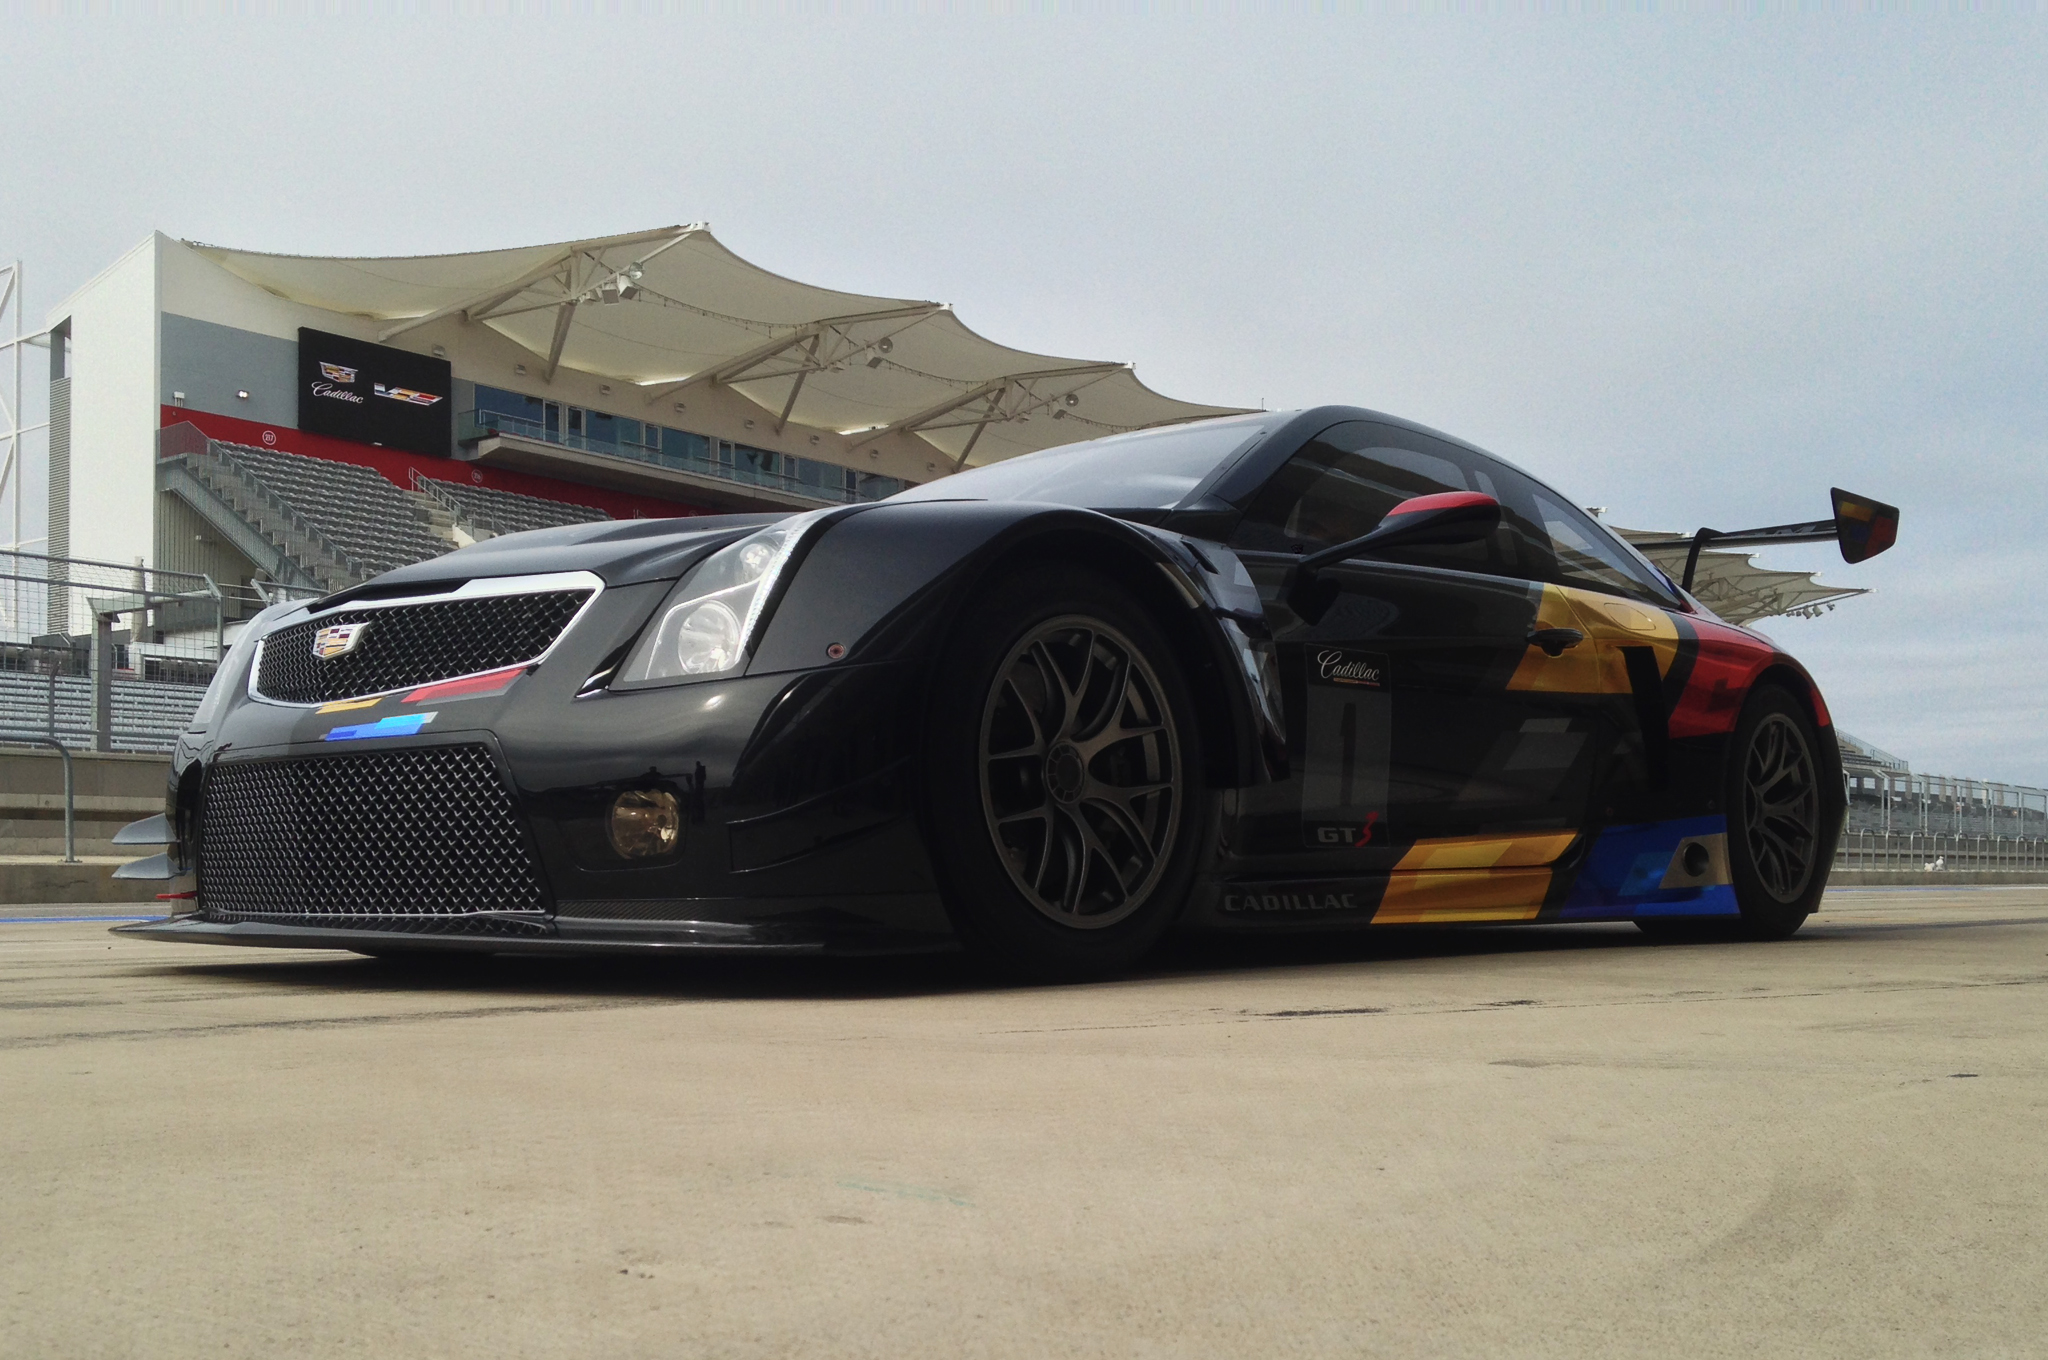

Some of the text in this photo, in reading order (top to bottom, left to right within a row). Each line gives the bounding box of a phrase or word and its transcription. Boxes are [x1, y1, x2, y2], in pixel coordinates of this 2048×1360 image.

[311, 382, 363, 403] Cadillac
[1317, 650, 1380, 681] Cadillac
[1340, 703, 1356, 805] 1
[1317, 811, 1378, 847] GT3
[1224, 894, 1358, 912] CADILLAC
